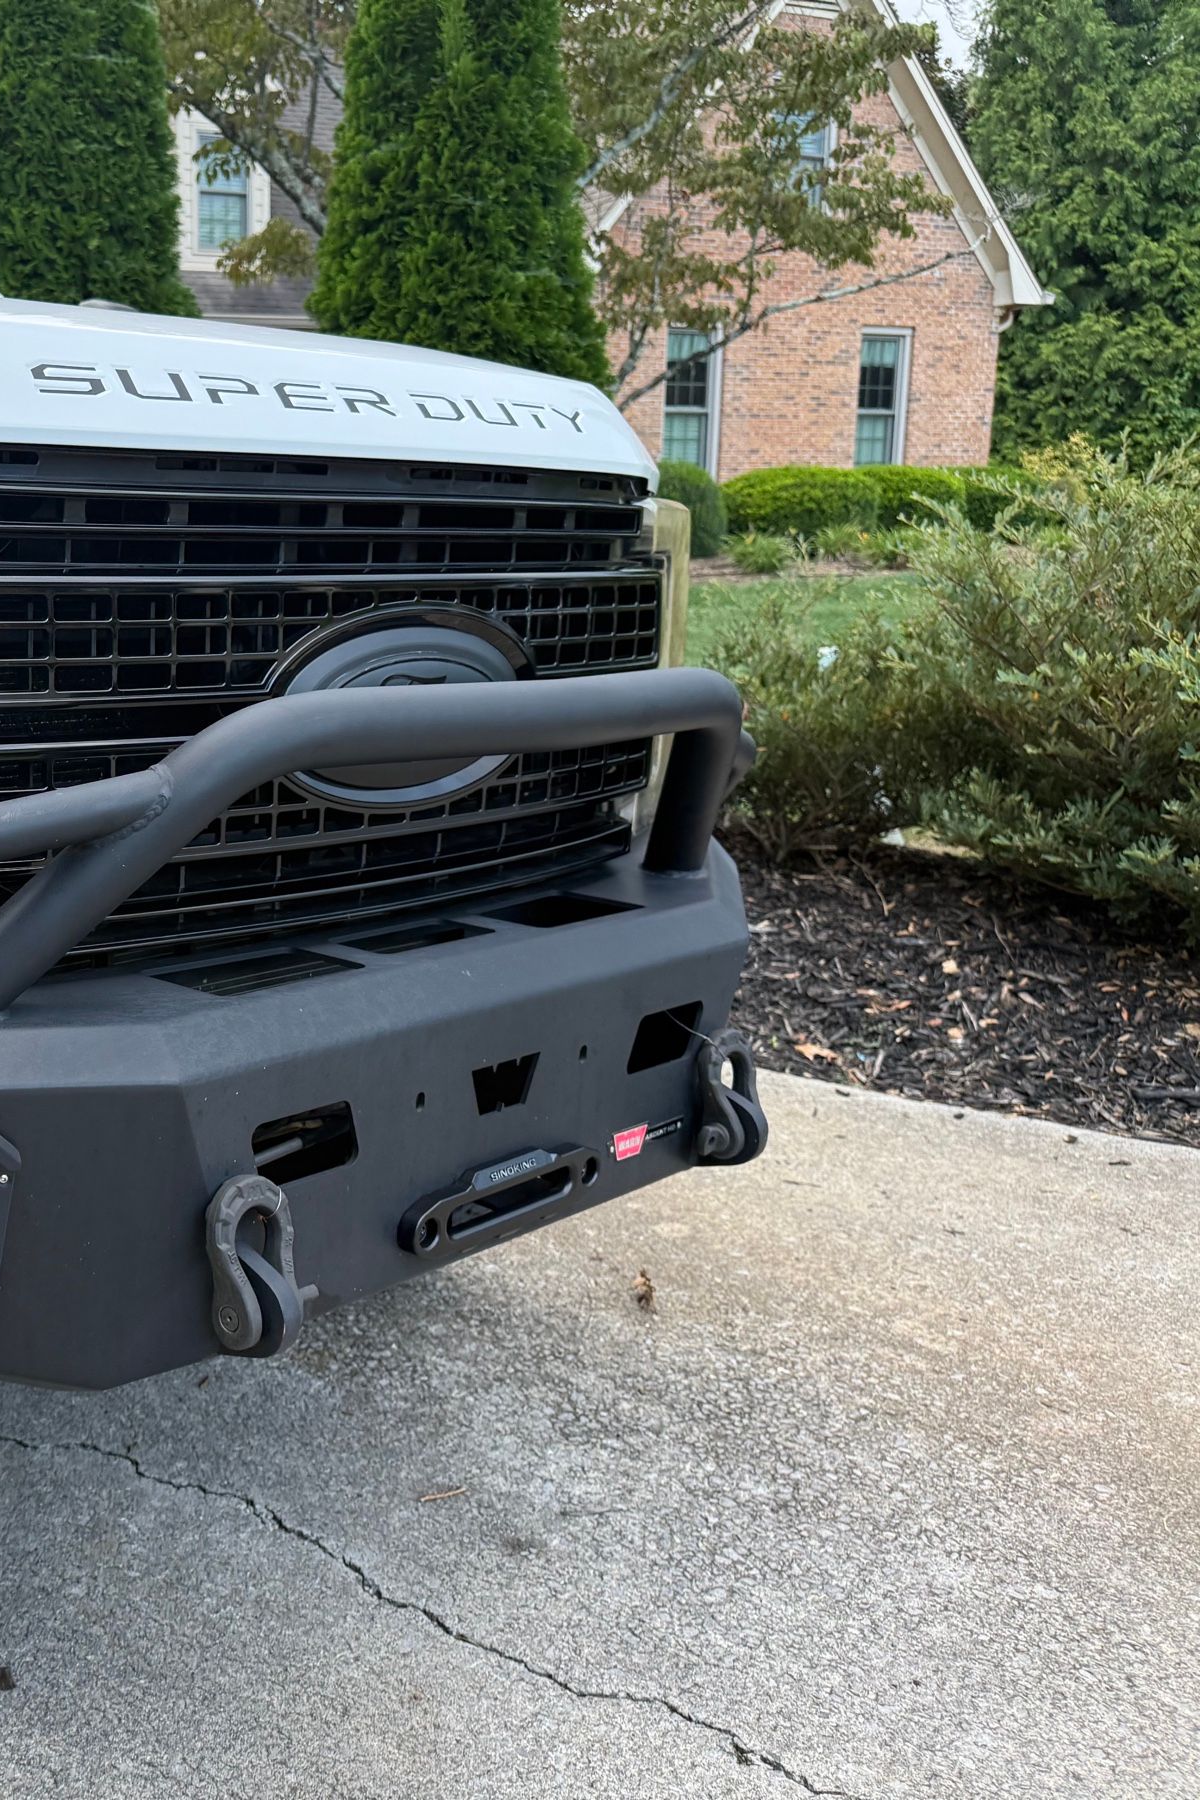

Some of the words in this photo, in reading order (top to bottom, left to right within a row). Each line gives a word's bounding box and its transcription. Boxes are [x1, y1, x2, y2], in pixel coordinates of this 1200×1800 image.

[30, 364, 397, 416] SUPER
[408, 393, 583, 433] DUTY
[490, 1158, 537, 1182] SINOKING
